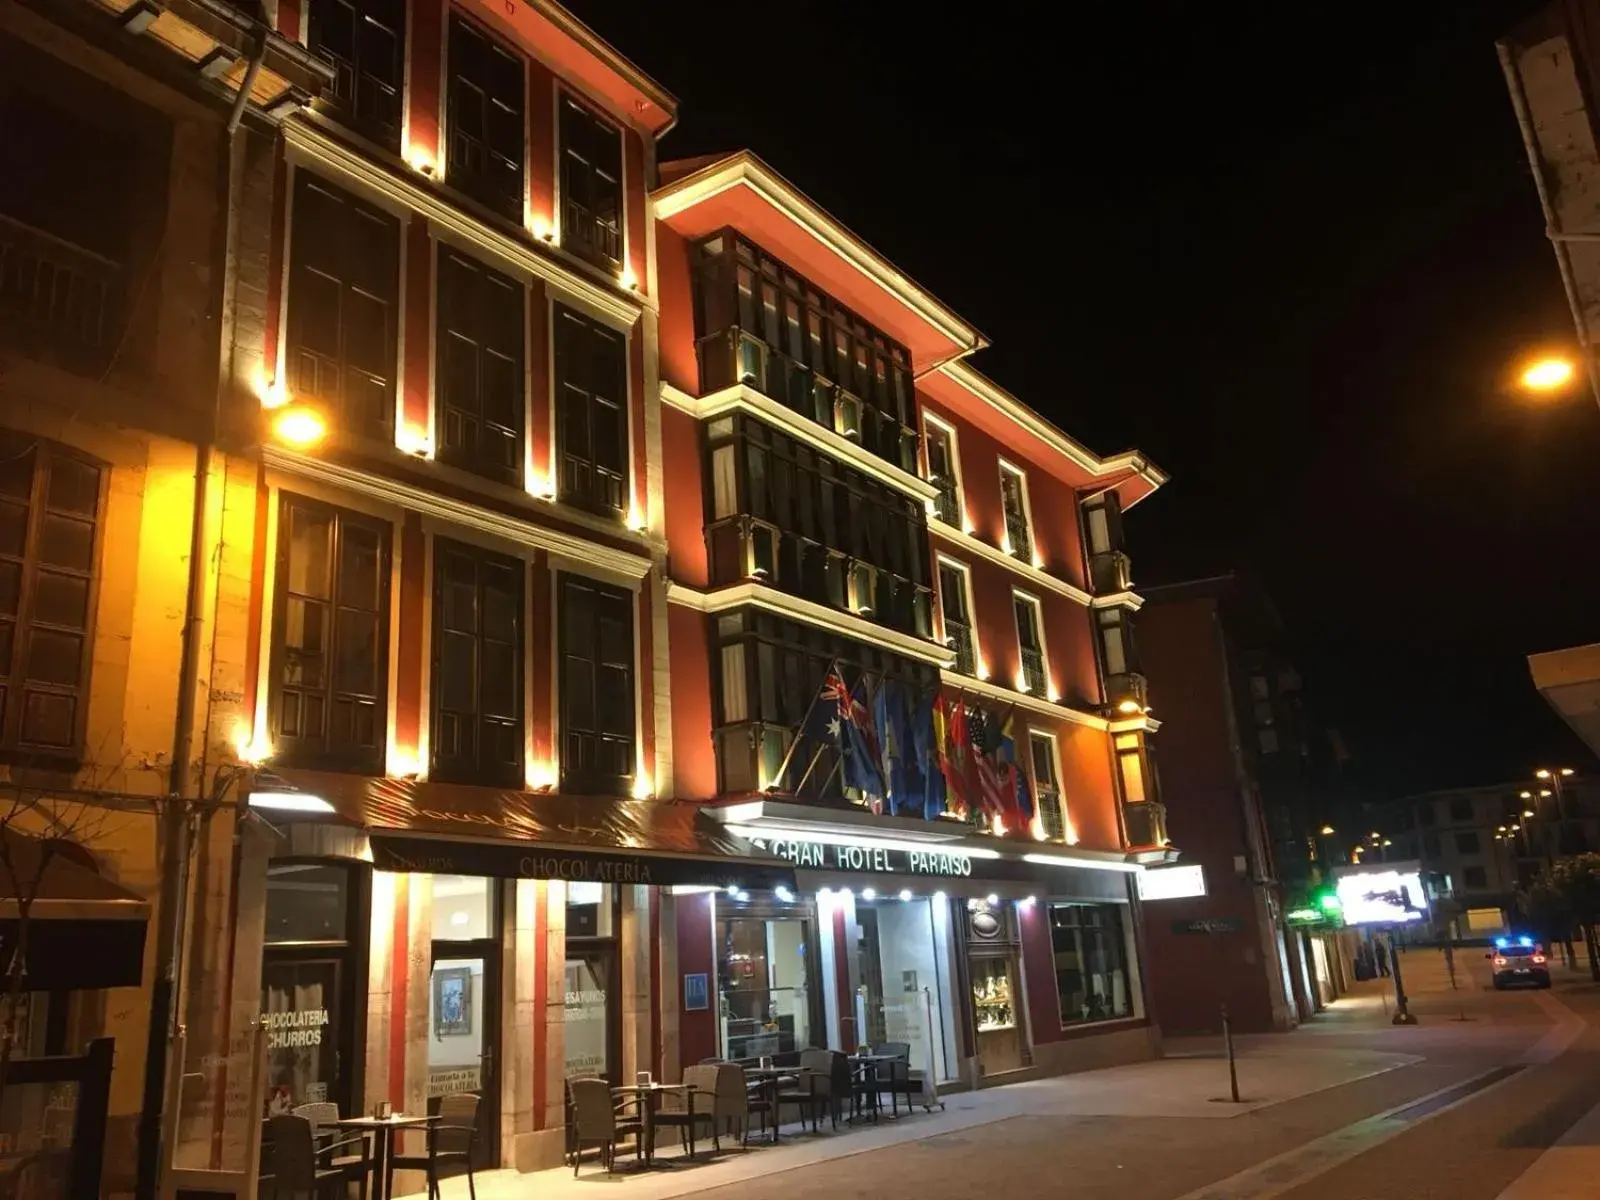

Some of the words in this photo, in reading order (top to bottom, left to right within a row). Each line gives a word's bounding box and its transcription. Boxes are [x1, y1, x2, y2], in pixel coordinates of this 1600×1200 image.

[773, 839, 824, 867] GRAN
[837, 846, 894, 872] HOTEL
[519, 856, 652, 882] CHOCOLATERÍA
[267, 1029, 322, 1049] CHURROS
